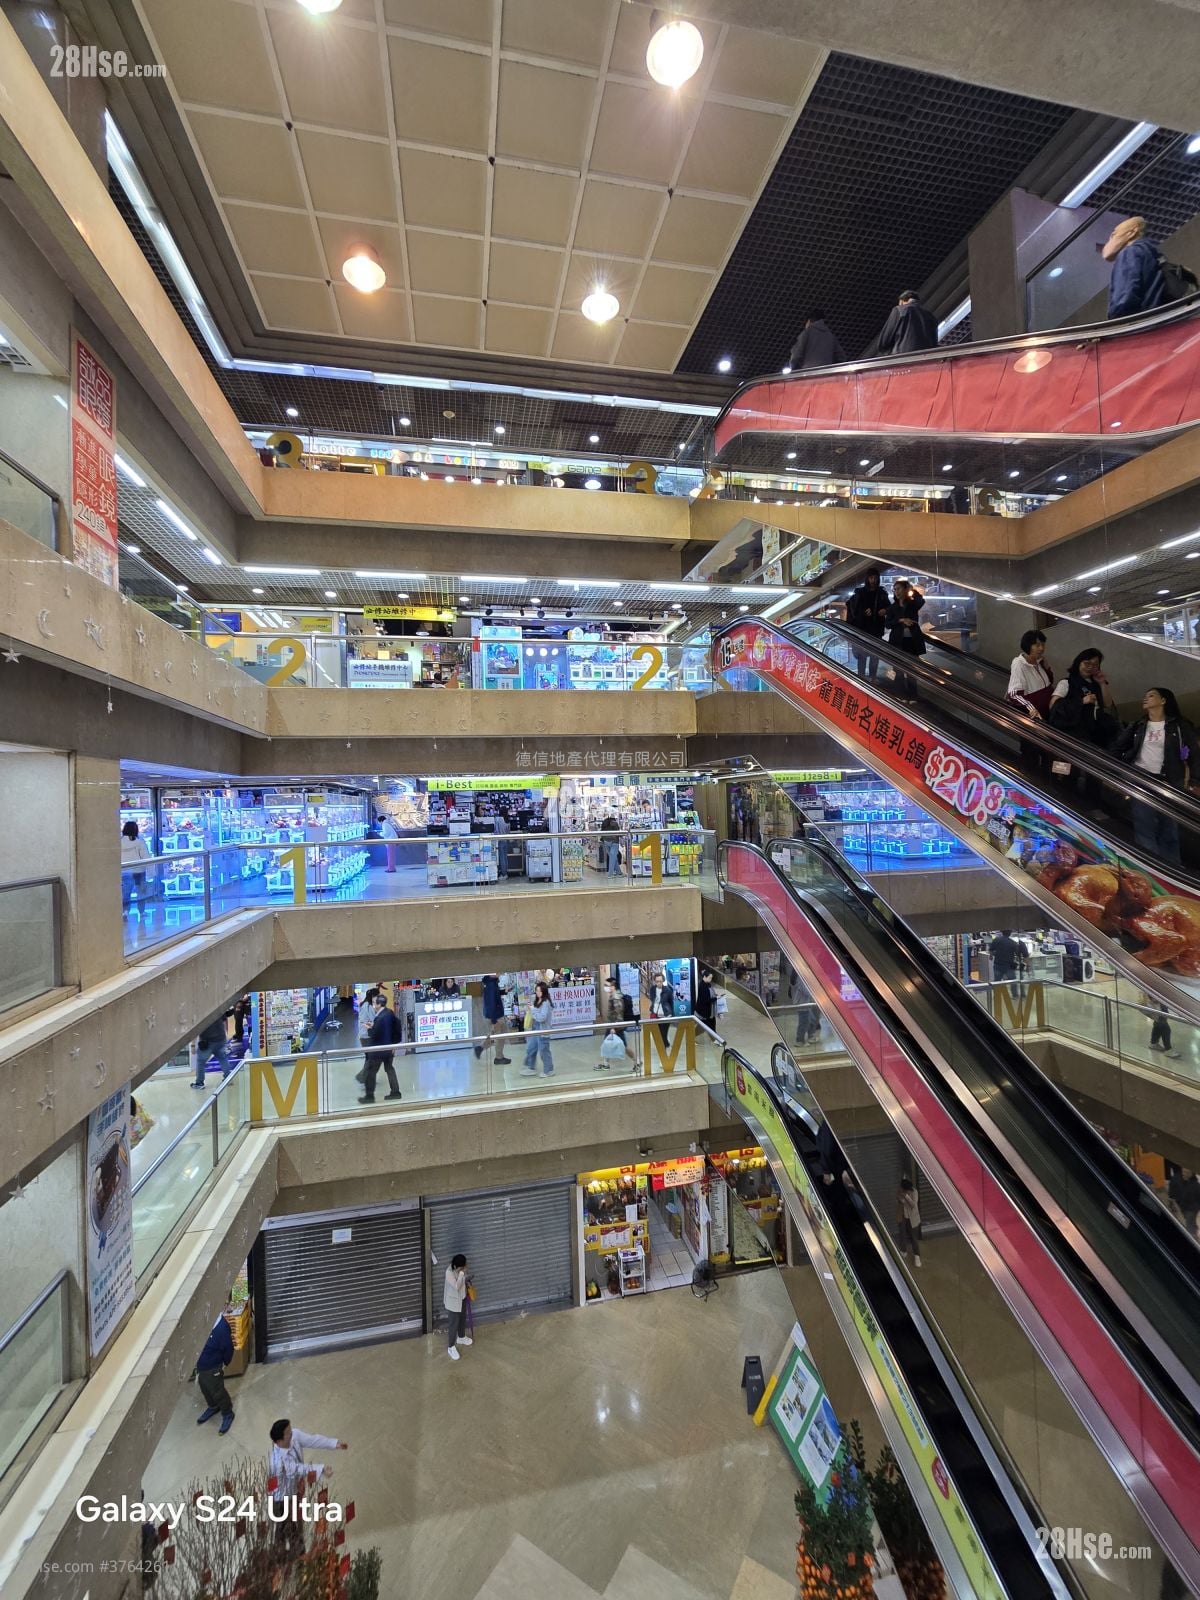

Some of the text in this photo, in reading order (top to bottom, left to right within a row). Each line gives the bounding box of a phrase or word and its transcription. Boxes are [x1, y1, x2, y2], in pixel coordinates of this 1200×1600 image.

[98, 446, 116, 523] 眼鏡
[267, 637, 306, 687] 2
[632, 645, 664, 690] 2
[818, 678, 927, 770] 龍寶馳名燒乳鴿
[436, 779, 472, 790] i-Best
[924, 746, 1005, 826] $20.8
[279, 847, 306, 904] 1
[640, 834, 663, 884] 1
[643, 1020, 696, 1076] M
[250, 1057, 319, 1121] M
